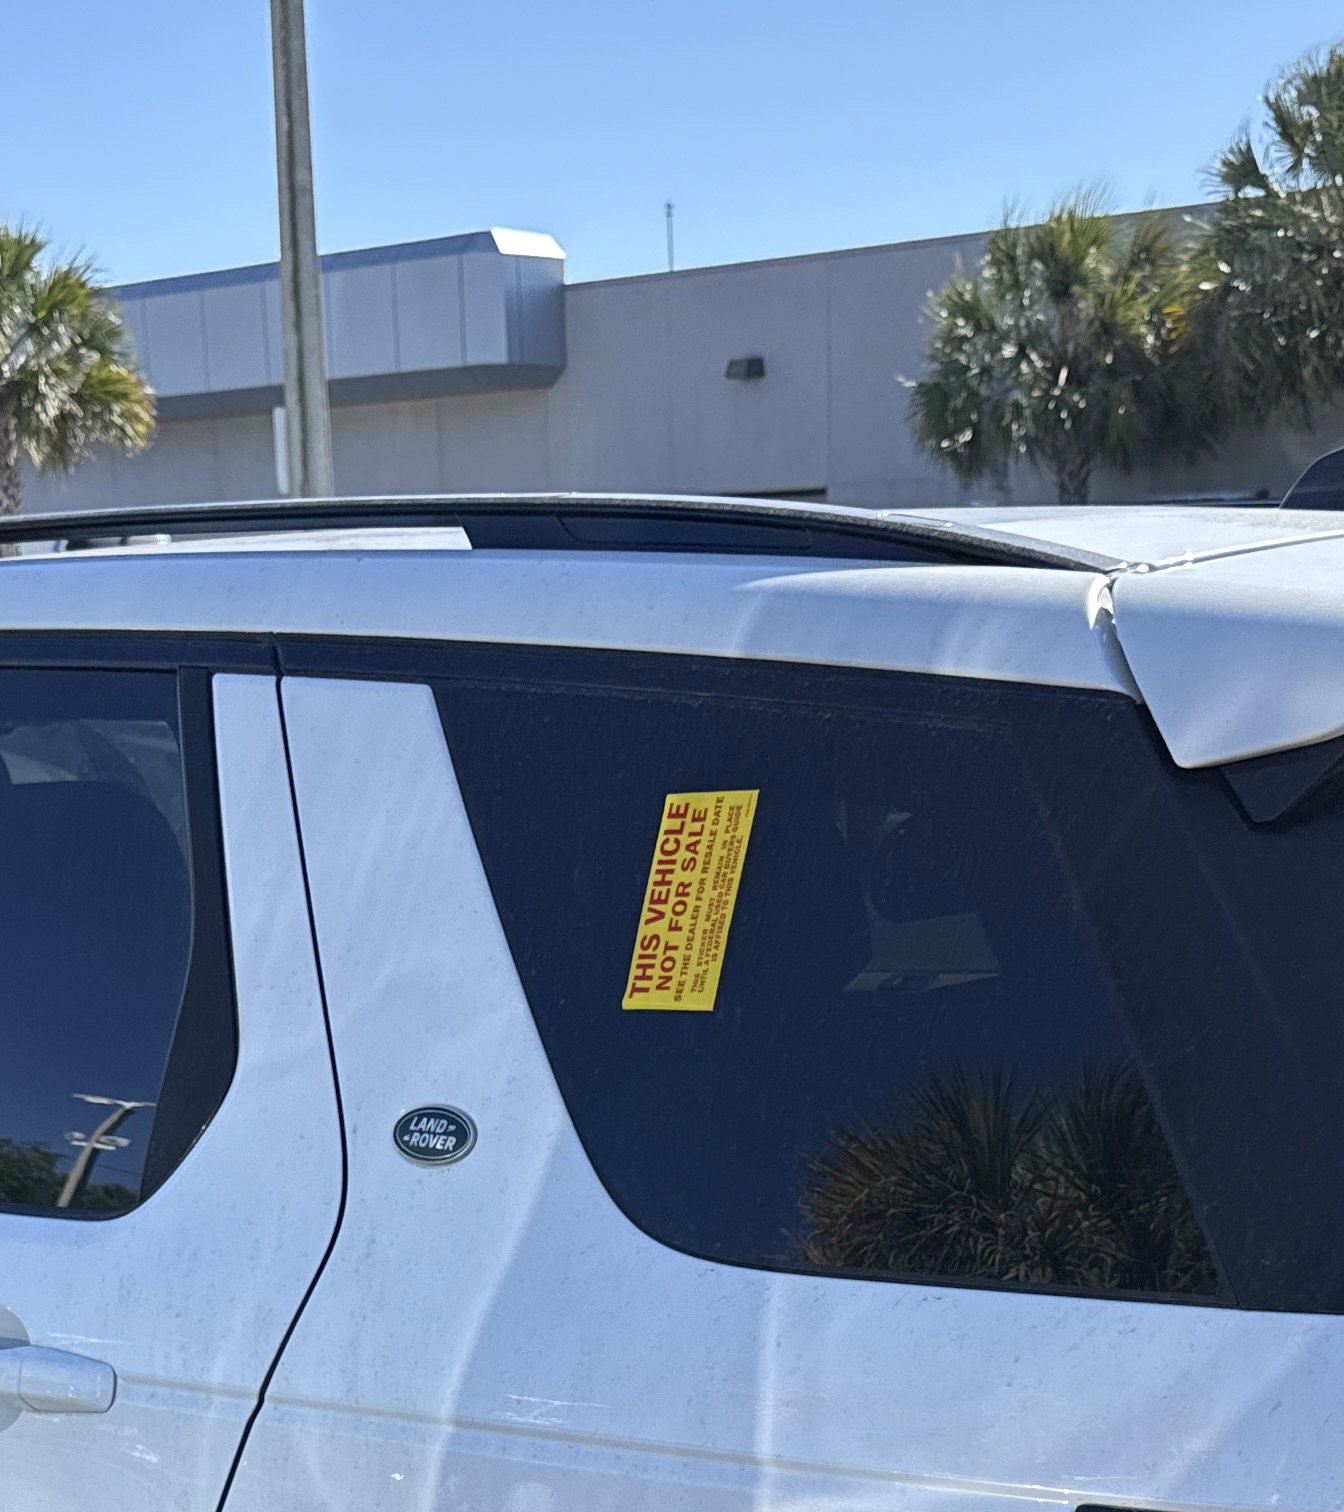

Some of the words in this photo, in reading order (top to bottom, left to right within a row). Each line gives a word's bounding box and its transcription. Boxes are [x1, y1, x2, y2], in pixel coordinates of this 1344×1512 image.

[711, 796, 725, 826] DATE
[724, 805, 736, 834] PLACE
[731, 804, 743, 832] GUIDE
[701, 828, 717, 874] RESALE
[720, 839, 729, 850] IN
[644, 802, 690, 927] VEHICLE
[712, 856, 725, 890] REMAIN
[695, 878, 707, 901] FOR
[718, 871, 728, 890] CAR
[724, 877, 734, 897] THIS
[656, 941, 678, 991] NOT
[667, 881, 693, 932] FOR
[681, 807, 708, 872] SALE
[705, 897, 716, 922] MUST
[713, 891, 724, 915] USED
[720, 899, 729, 910] TO
[685, 904, 701, 950] DEALER
[705, 917, 719, 957] FEDERAL
[713, 912, 726, 951] AFFIXED
[697, 928, 709, 966] STICKER
[628, 933, 661, 999] THIS
[680, 954, 691, 977] THE
[674, 980, 686, 1002] SEE
[690, 973, 701, 993] THIS
[697, 968, 709, 993] UNTIL
[409, 1116, 448, 1134] LAND
[409, 1132, 457, 1152] ROVER
